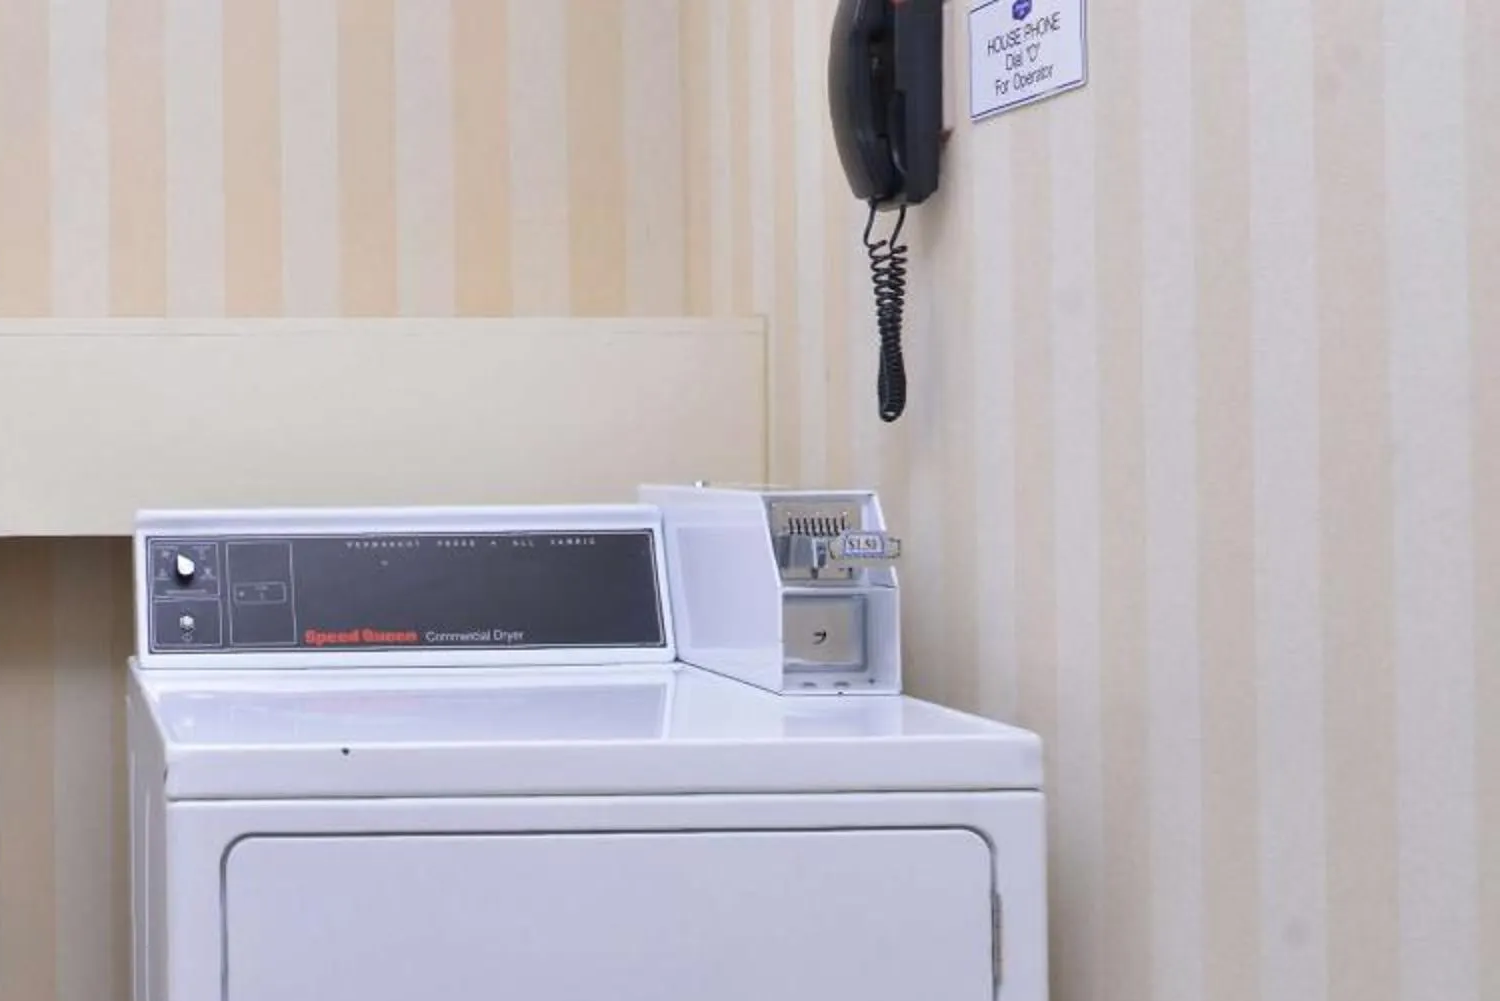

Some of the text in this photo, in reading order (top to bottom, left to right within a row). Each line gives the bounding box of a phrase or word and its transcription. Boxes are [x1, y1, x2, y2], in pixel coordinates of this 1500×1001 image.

[987, 11, 1061, 56] HOUSE PHONE
[1005, 51, 1022, 71] Dial
[995, 64, 1053, 96] For Operator
[305, 628, 525, 648] Speed Queen Commercial Dryer
